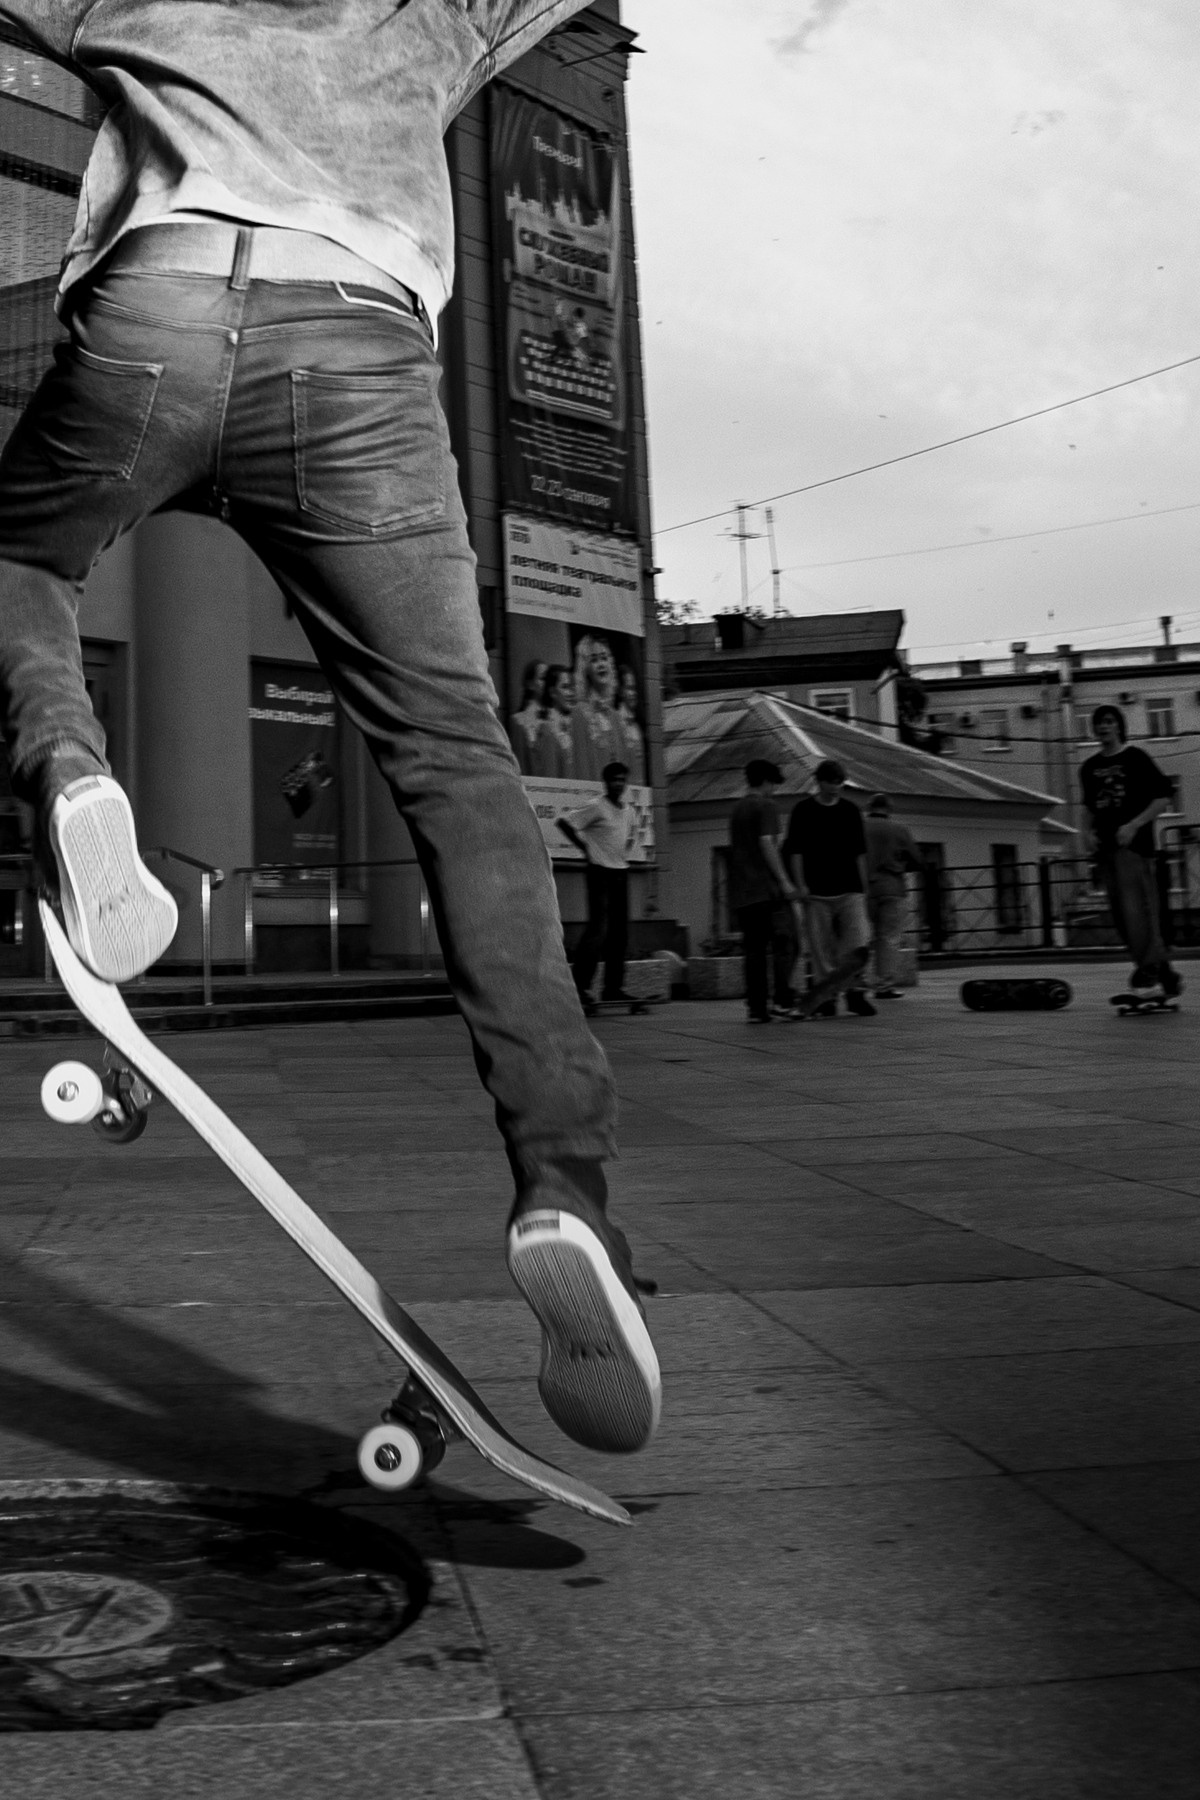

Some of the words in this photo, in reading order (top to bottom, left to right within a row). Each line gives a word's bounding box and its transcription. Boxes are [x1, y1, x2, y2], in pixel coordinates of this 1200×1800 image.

[511, 554, 559, 573] летняя
[562, 565, 639, 591] театральная
[511, 575, 581, 598] площадка
